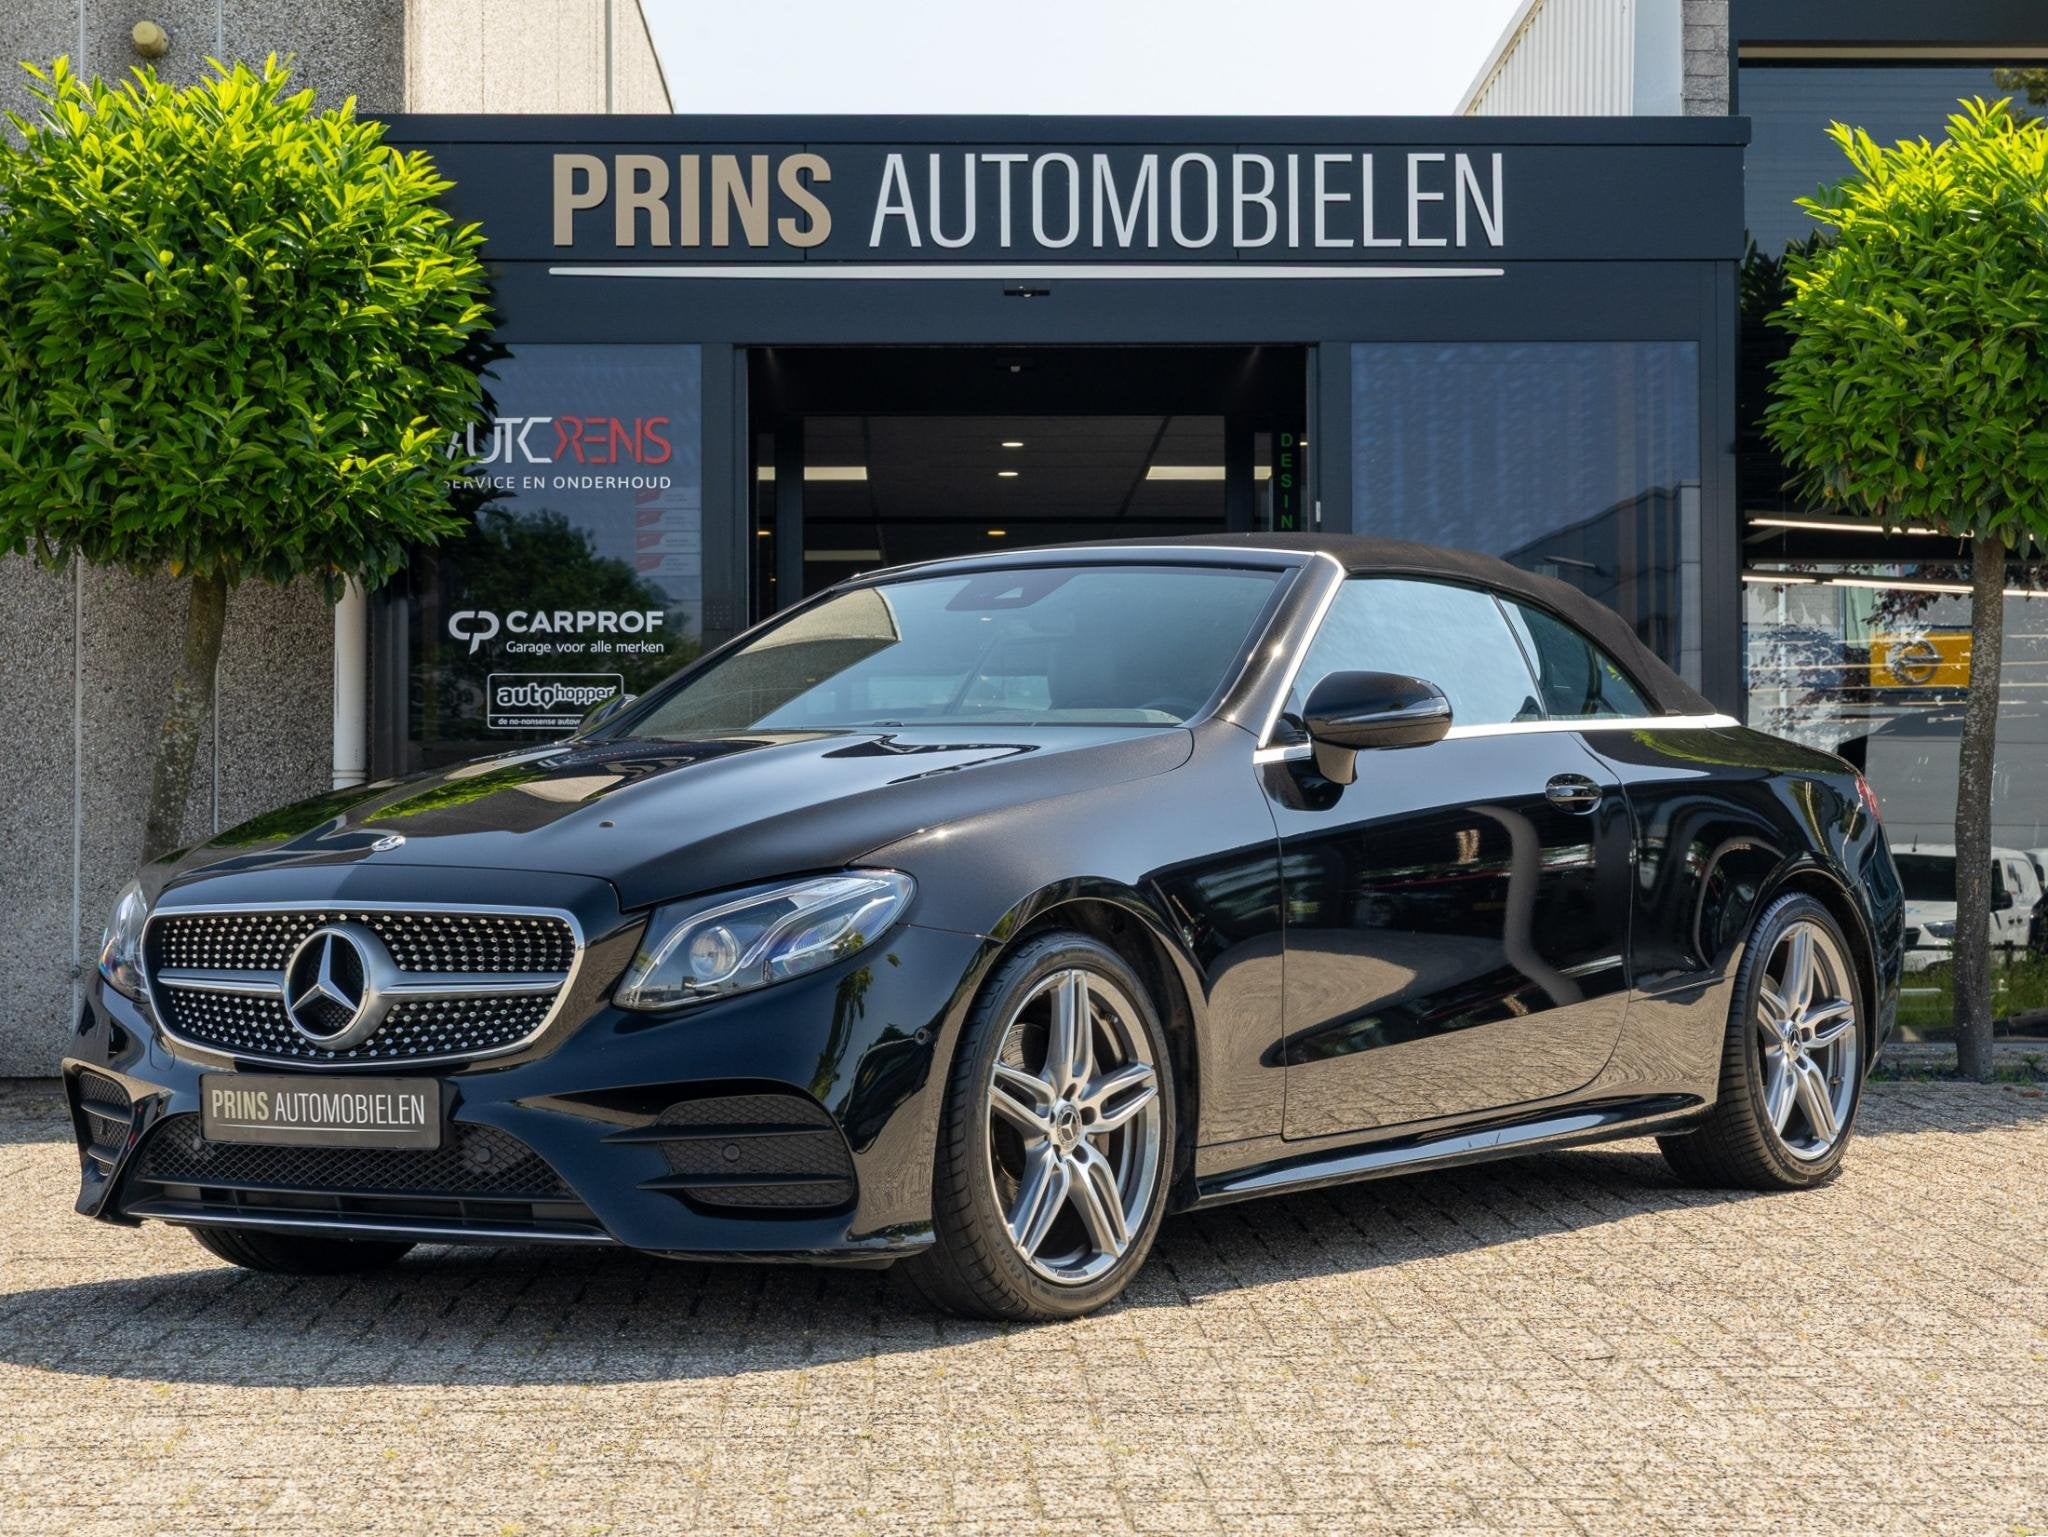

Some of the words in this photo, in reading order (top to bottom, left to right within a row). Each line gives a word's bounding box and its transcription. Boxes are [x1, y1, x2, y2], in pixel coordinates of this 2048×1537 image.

[552, 152, 832, 249] PRINS
[869, 152, 1505, 249] AUTOMOBIELEN
[523, 476, 545, 489] EN
[553, 476, 672, 489] ONDERHOUD
[506, 610, 664, 633] CARPROF
[506, 640, 552, 656] Garage
[556, 644, 585, 653] voor
[590, 640, 612, 653] alle
[616, 640, 664, 653] merken
[211, 1088, 269, 1121] PRINS
[274, 1092, 425, 1125] AUTOMOBIELEN
